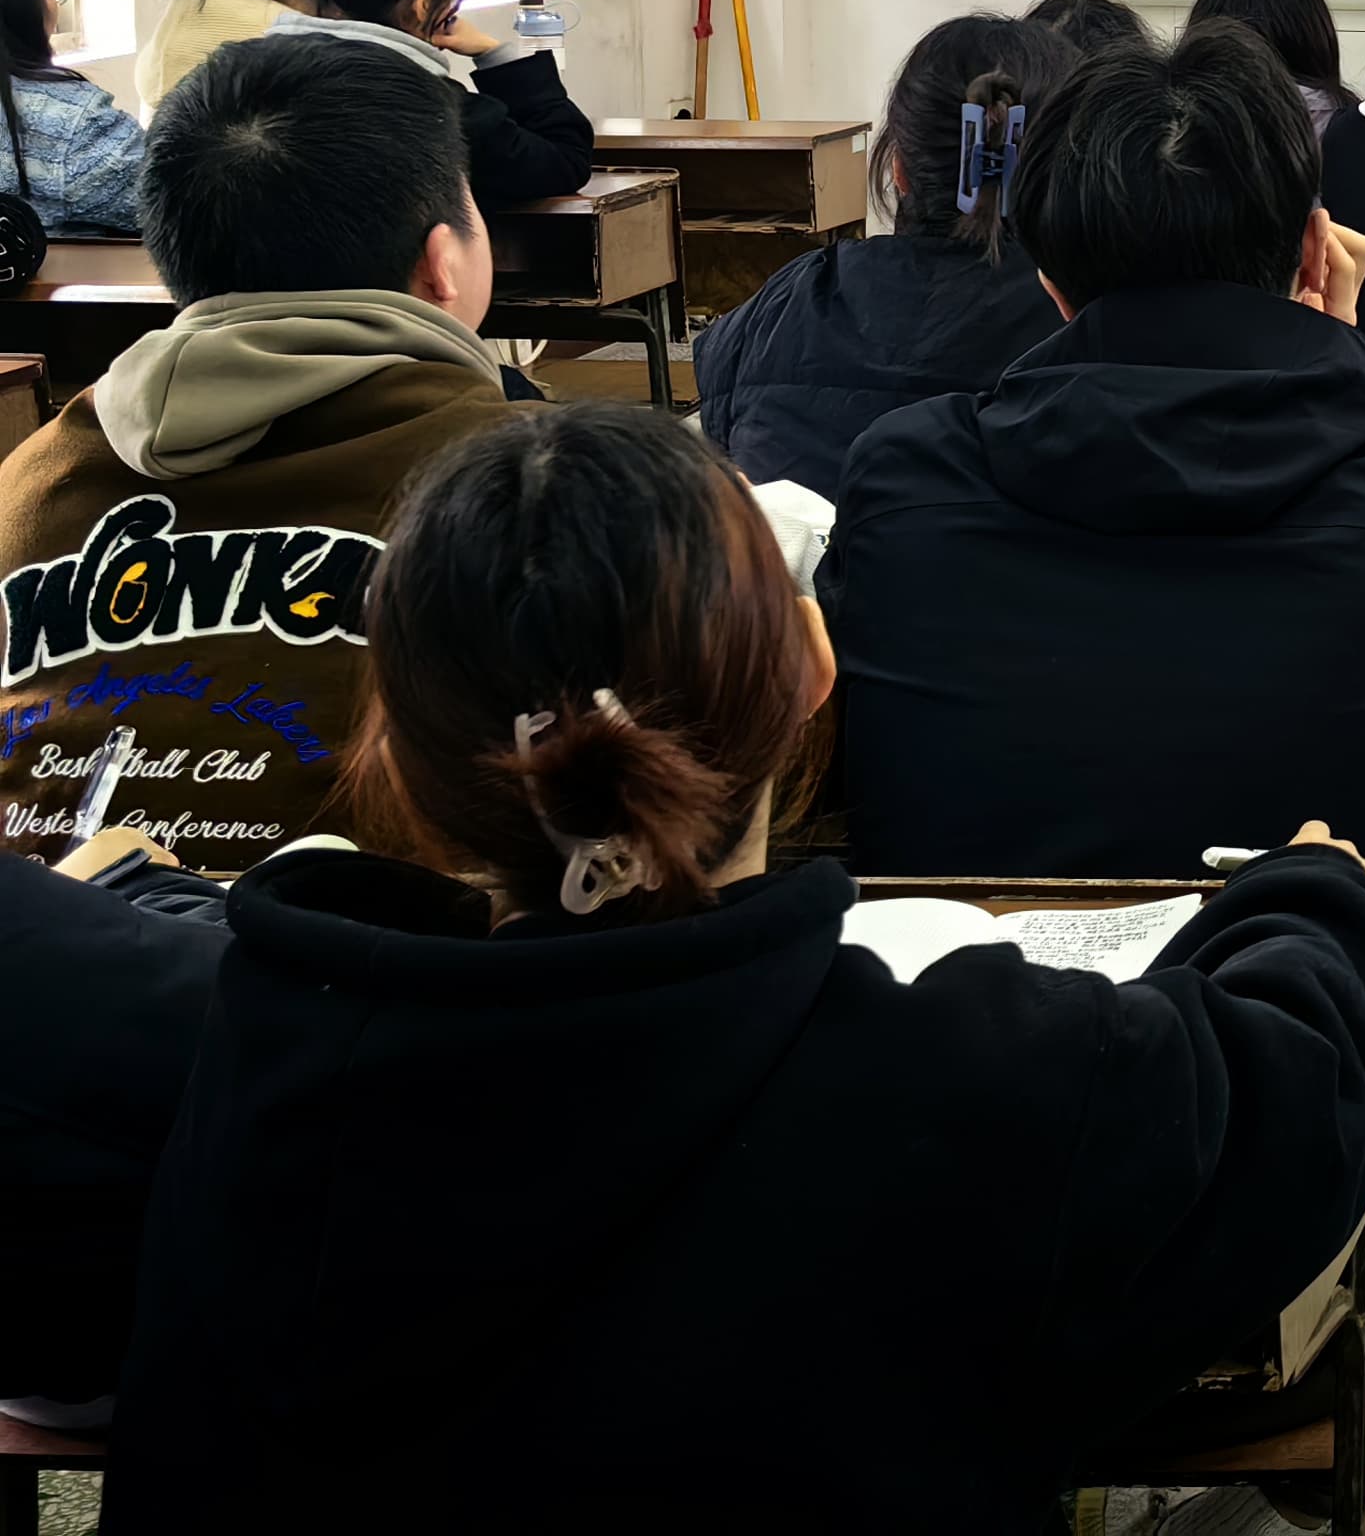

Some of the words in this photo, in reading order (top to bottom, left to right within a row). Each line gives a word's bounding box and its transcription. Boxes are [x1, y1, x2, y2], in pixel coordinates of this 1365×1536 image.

[67, 660, 213, 716] Angeles
[210, 681, 334, 764] Lakers
[31, 743, 191, 780] Basktball
[192, 749, 272, 783] Club
